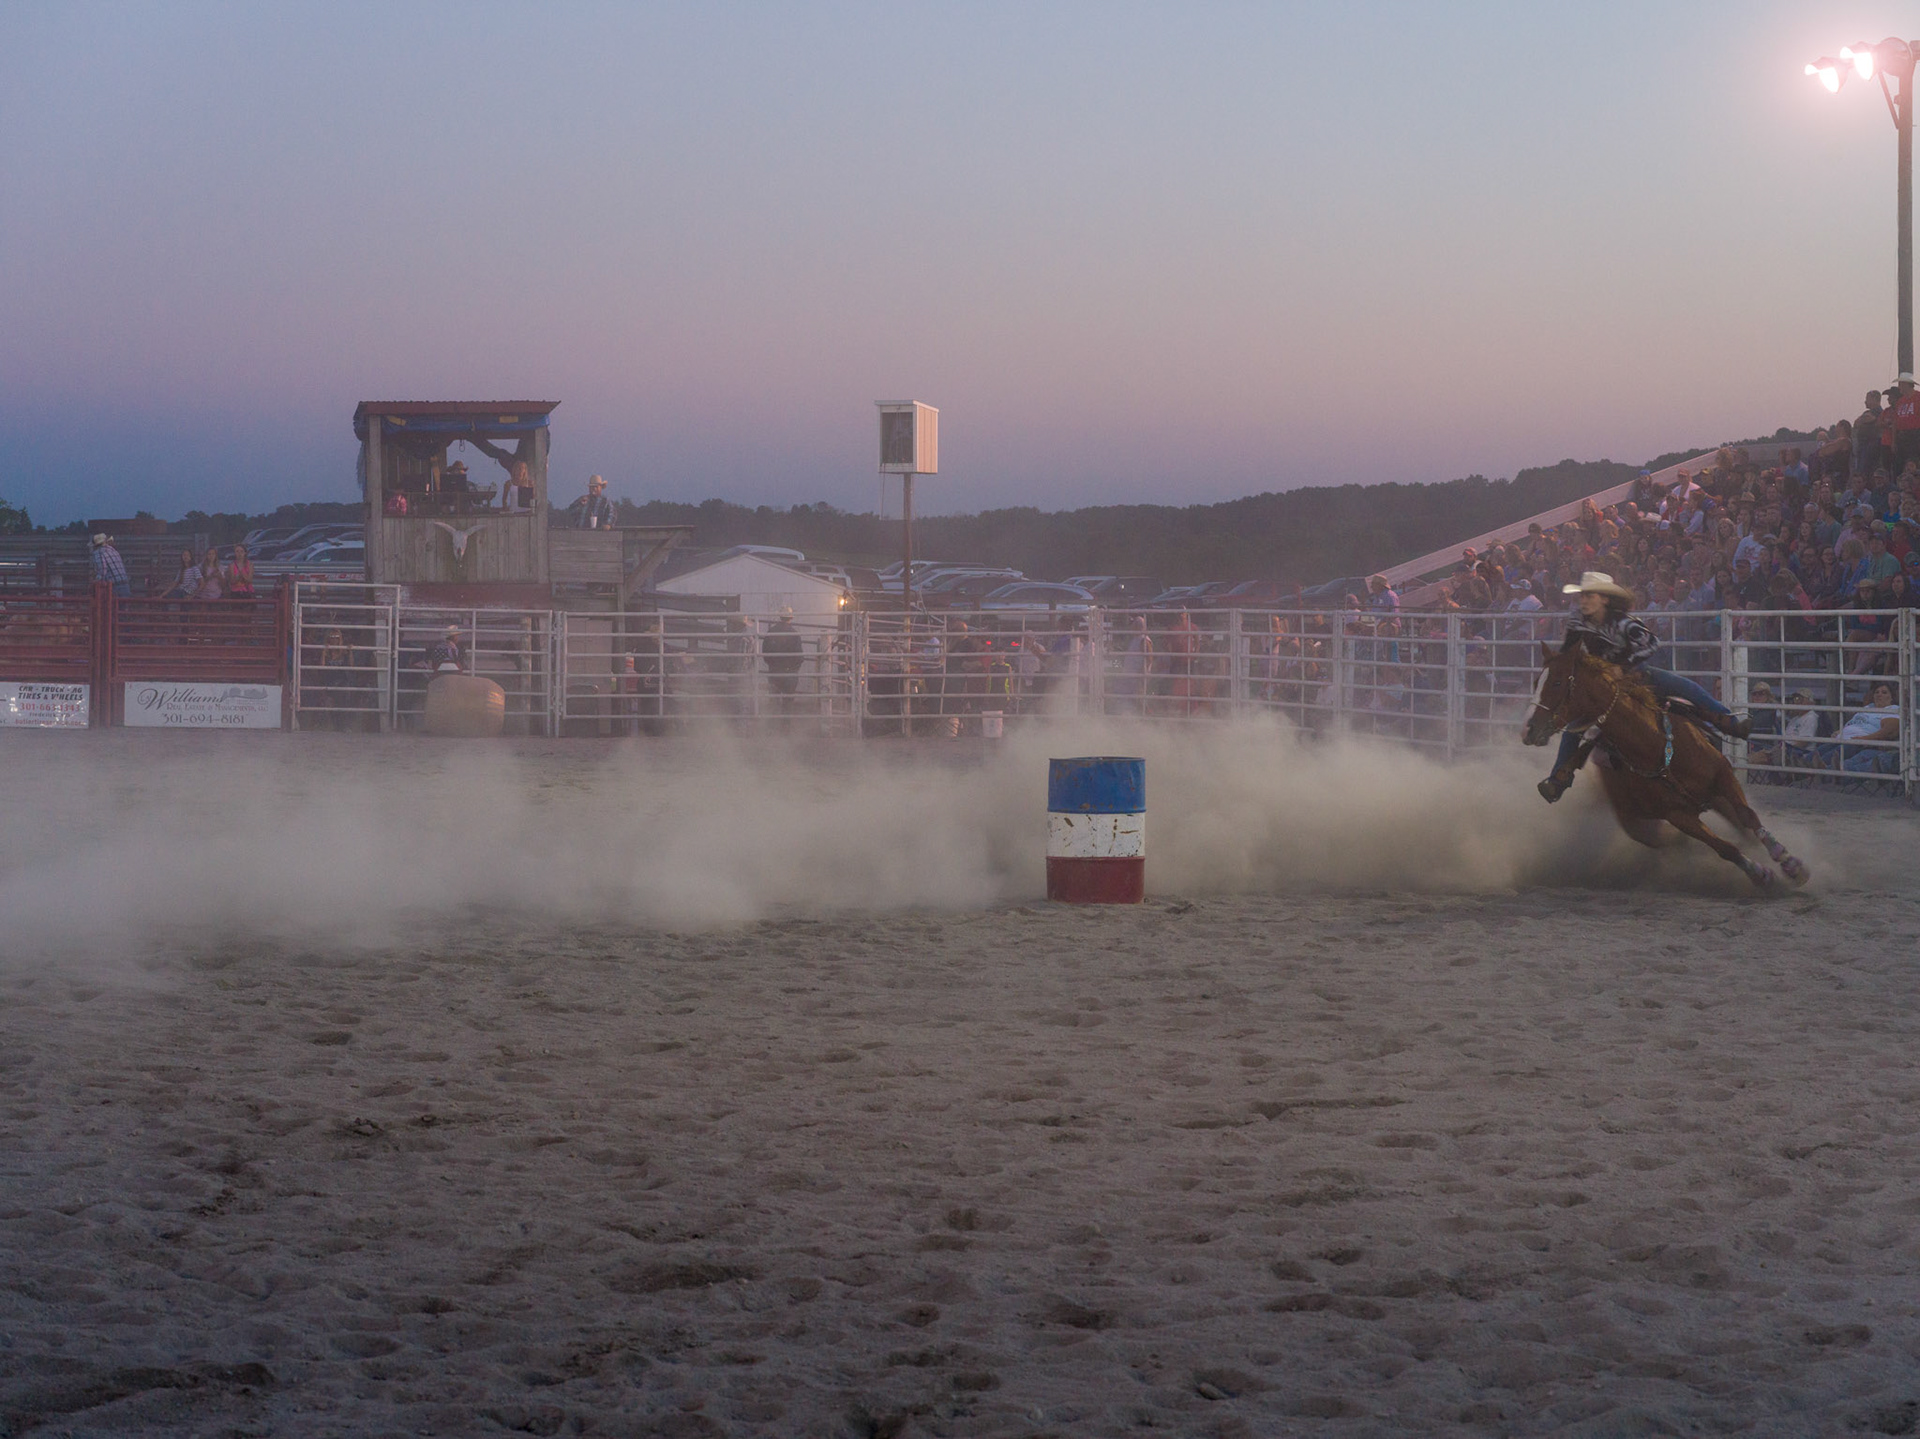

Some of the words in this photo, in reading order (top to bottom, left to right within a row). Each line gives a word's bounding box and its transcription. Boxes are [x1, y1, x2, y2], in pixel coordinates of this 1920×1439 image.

[18, 692, 42, 700] TIRES
[51, 693, 84, 701] WHEELS
[137, 688, 226, 710] Williams
[162, 713, 245, 724] 301-694-8181
